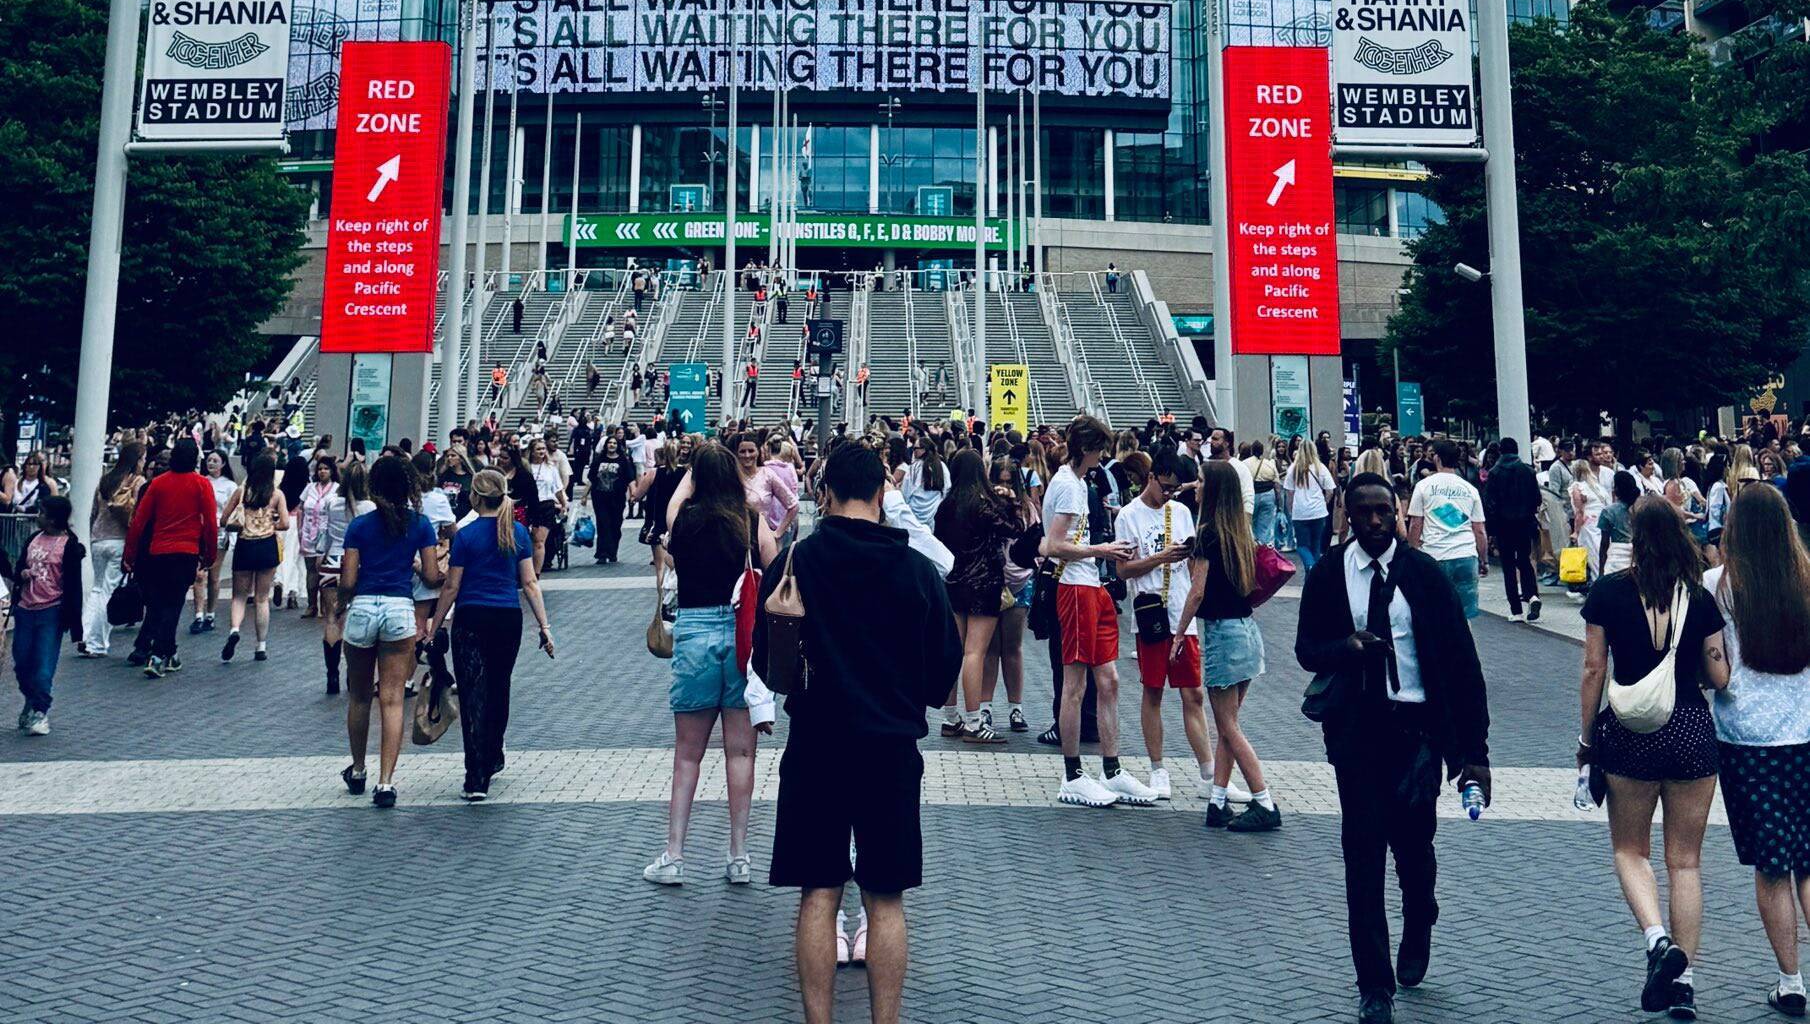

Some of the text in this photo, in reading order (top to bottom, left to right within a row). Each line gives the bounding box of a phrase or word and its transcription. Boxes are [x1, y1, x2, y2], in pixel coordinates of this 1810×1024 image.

[552, 14, 628, 48] ALL
[642, 13, 816, 47] WAITING
[831, 14, 968, 49] THERE
[984, 16, 1065, 51] FOR
[1079, 19, 1161, 55] YOU
[165, 30, 270, 69] TOGETHER
[1353, 36, 1453, 75] TOGETHER
[550, 51, 628, 84] ALL
[641, 50, 816, 83] WAITING
[829, 51, 968, 84] THERE
[984, 53, 1065, 87] FOR
[1079, 55, 1161, 90] YOU
[150, 83, 278, 100] WEMBLEY
[367, 80, 415, 99] RED
[1256, 85, 1303, 104] RED
[1343, 88, 1466, 105] WEMBLEY
[149, 102, 276, 120] STADIUM
[1343, 107, 1467, 125] STADIUM
[355, 113, 421, 133] ZONE
[1249, 118, 1312, 137] ZONE
[335, 219, 429, 234] Keep right of
[684, 222, 724, 238] GREEN
[735, 222, 760, 238] ONE
[864, 224, 875, 242] F,
[877, 224, 889, 242] E,
[891, 224, 900, 240] D
[902, 224, 911, 240] &
[913, 224, 954, 242] BOBBY
[956, 225, 1003, 243] MORE.
[1239, 222, 1330, 237] Keep right of
[347, 240, 413, 255] the steps
[1253, 243, 1317, 257] the steps
[343, 261, 414, 276] and along
[1251, 264, 1321, 280] and along
[354, 281, 401, 295] Pacific
[1264, 284, 1310, 298] Pacific
[344, 303, 407, 316] Crescent
[1257, 305, 1319, 319] Crescent
[996, 369, 1023, 377] YELLOW
[1001, 378, 1018, 386] ZONE
